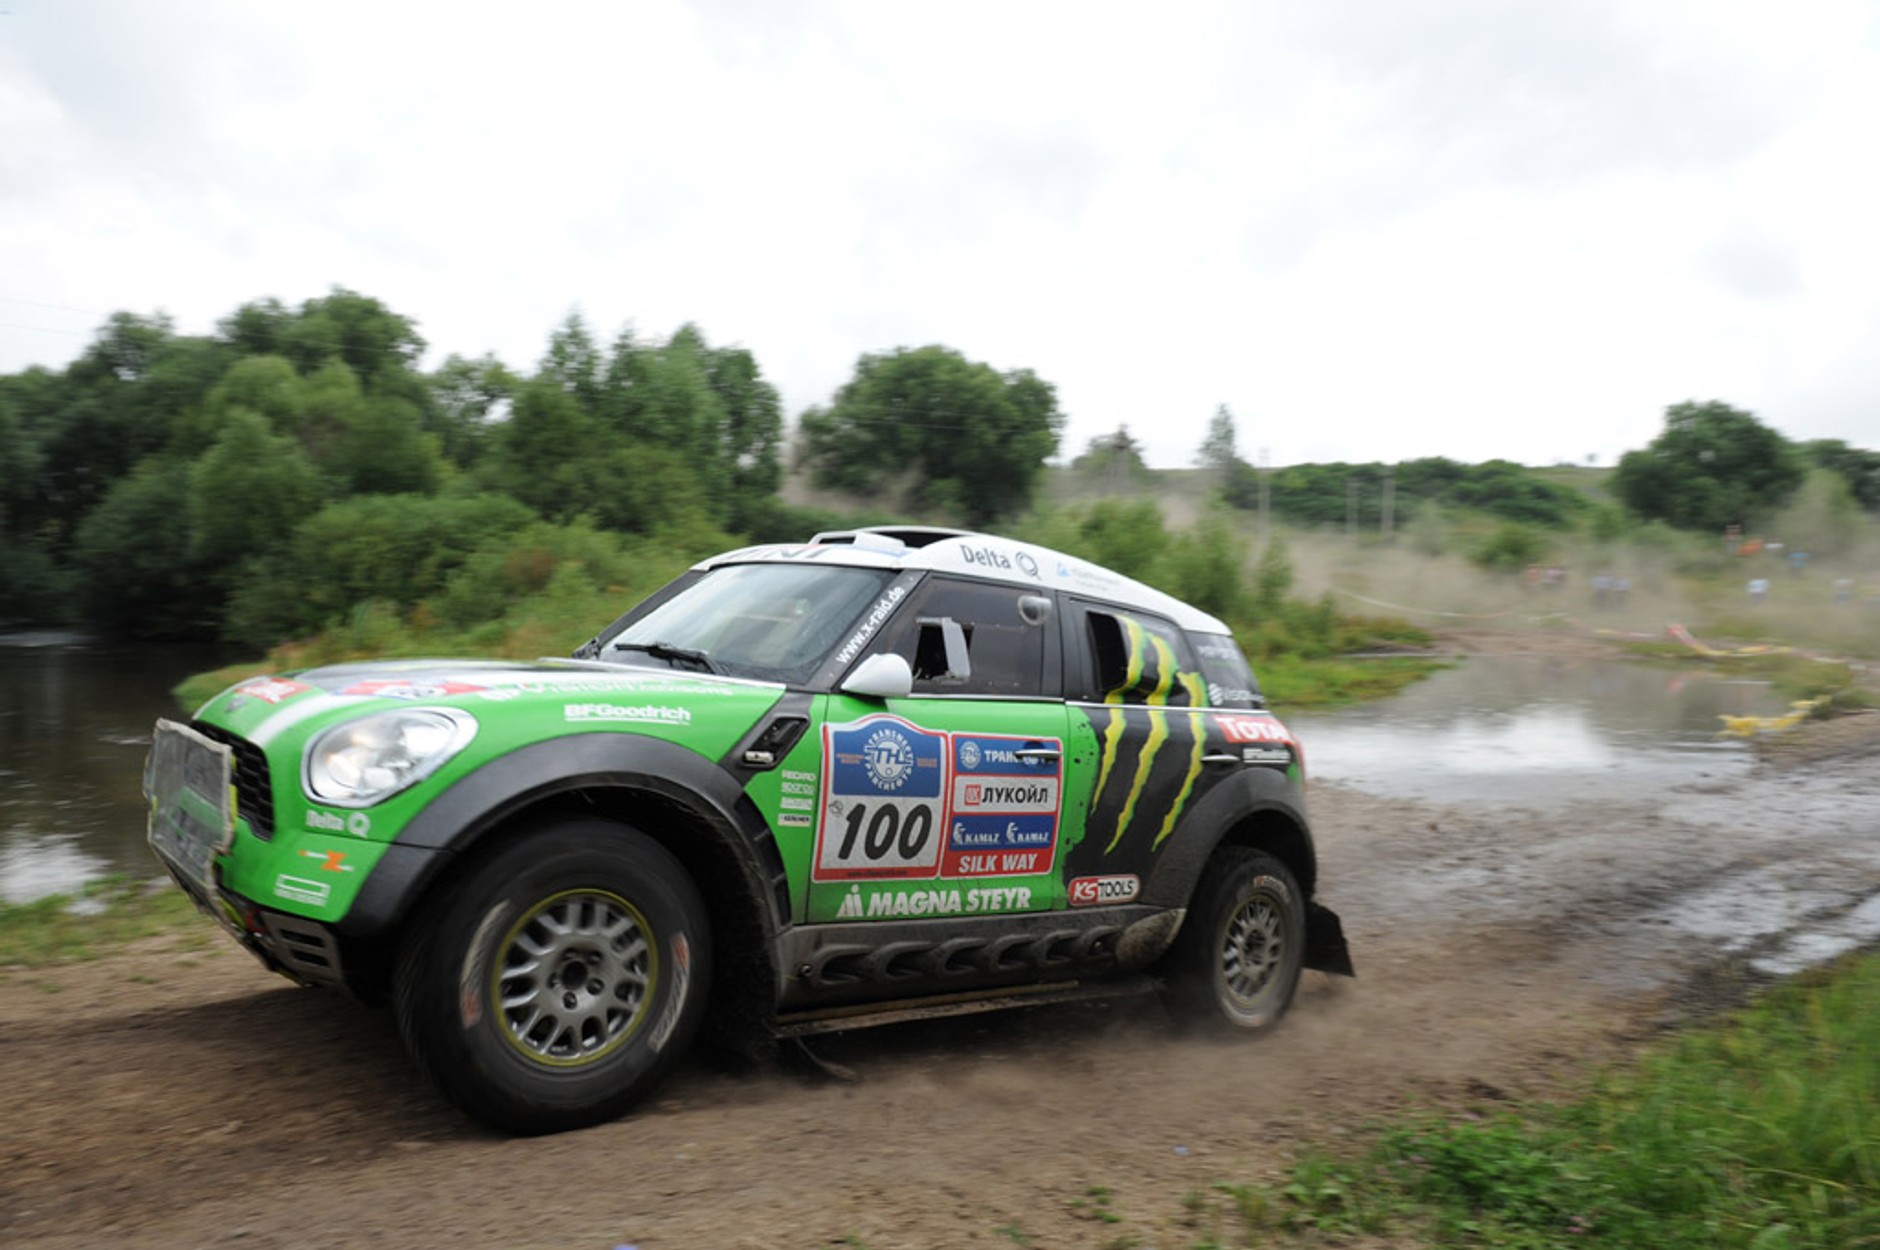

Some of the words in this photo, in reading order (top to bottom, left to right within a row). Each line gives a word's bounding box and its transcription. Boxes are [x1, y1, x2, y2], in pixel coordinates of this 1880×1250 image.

[960, 544, 1011, 569] Delta
[1015, 551, 1041, 580] Q
[835, 586, 905, 664] www.x-raid.de
[564, 703, 691, 721] BFGoodrich
[982, 784, 1048, 804] ЛУКОЙЛ
[837, 803, 932, 861] 100
[959, 855, 998, 873] SILK
[1002, 853, 1038, 871] WAY
[867, 890, 961, 917] MAGNA
[966, 887, 1031, 912] STEYR
[1073, 881, 1097, 902] KS
[1098, 880, 1133, 897] TOOLS
